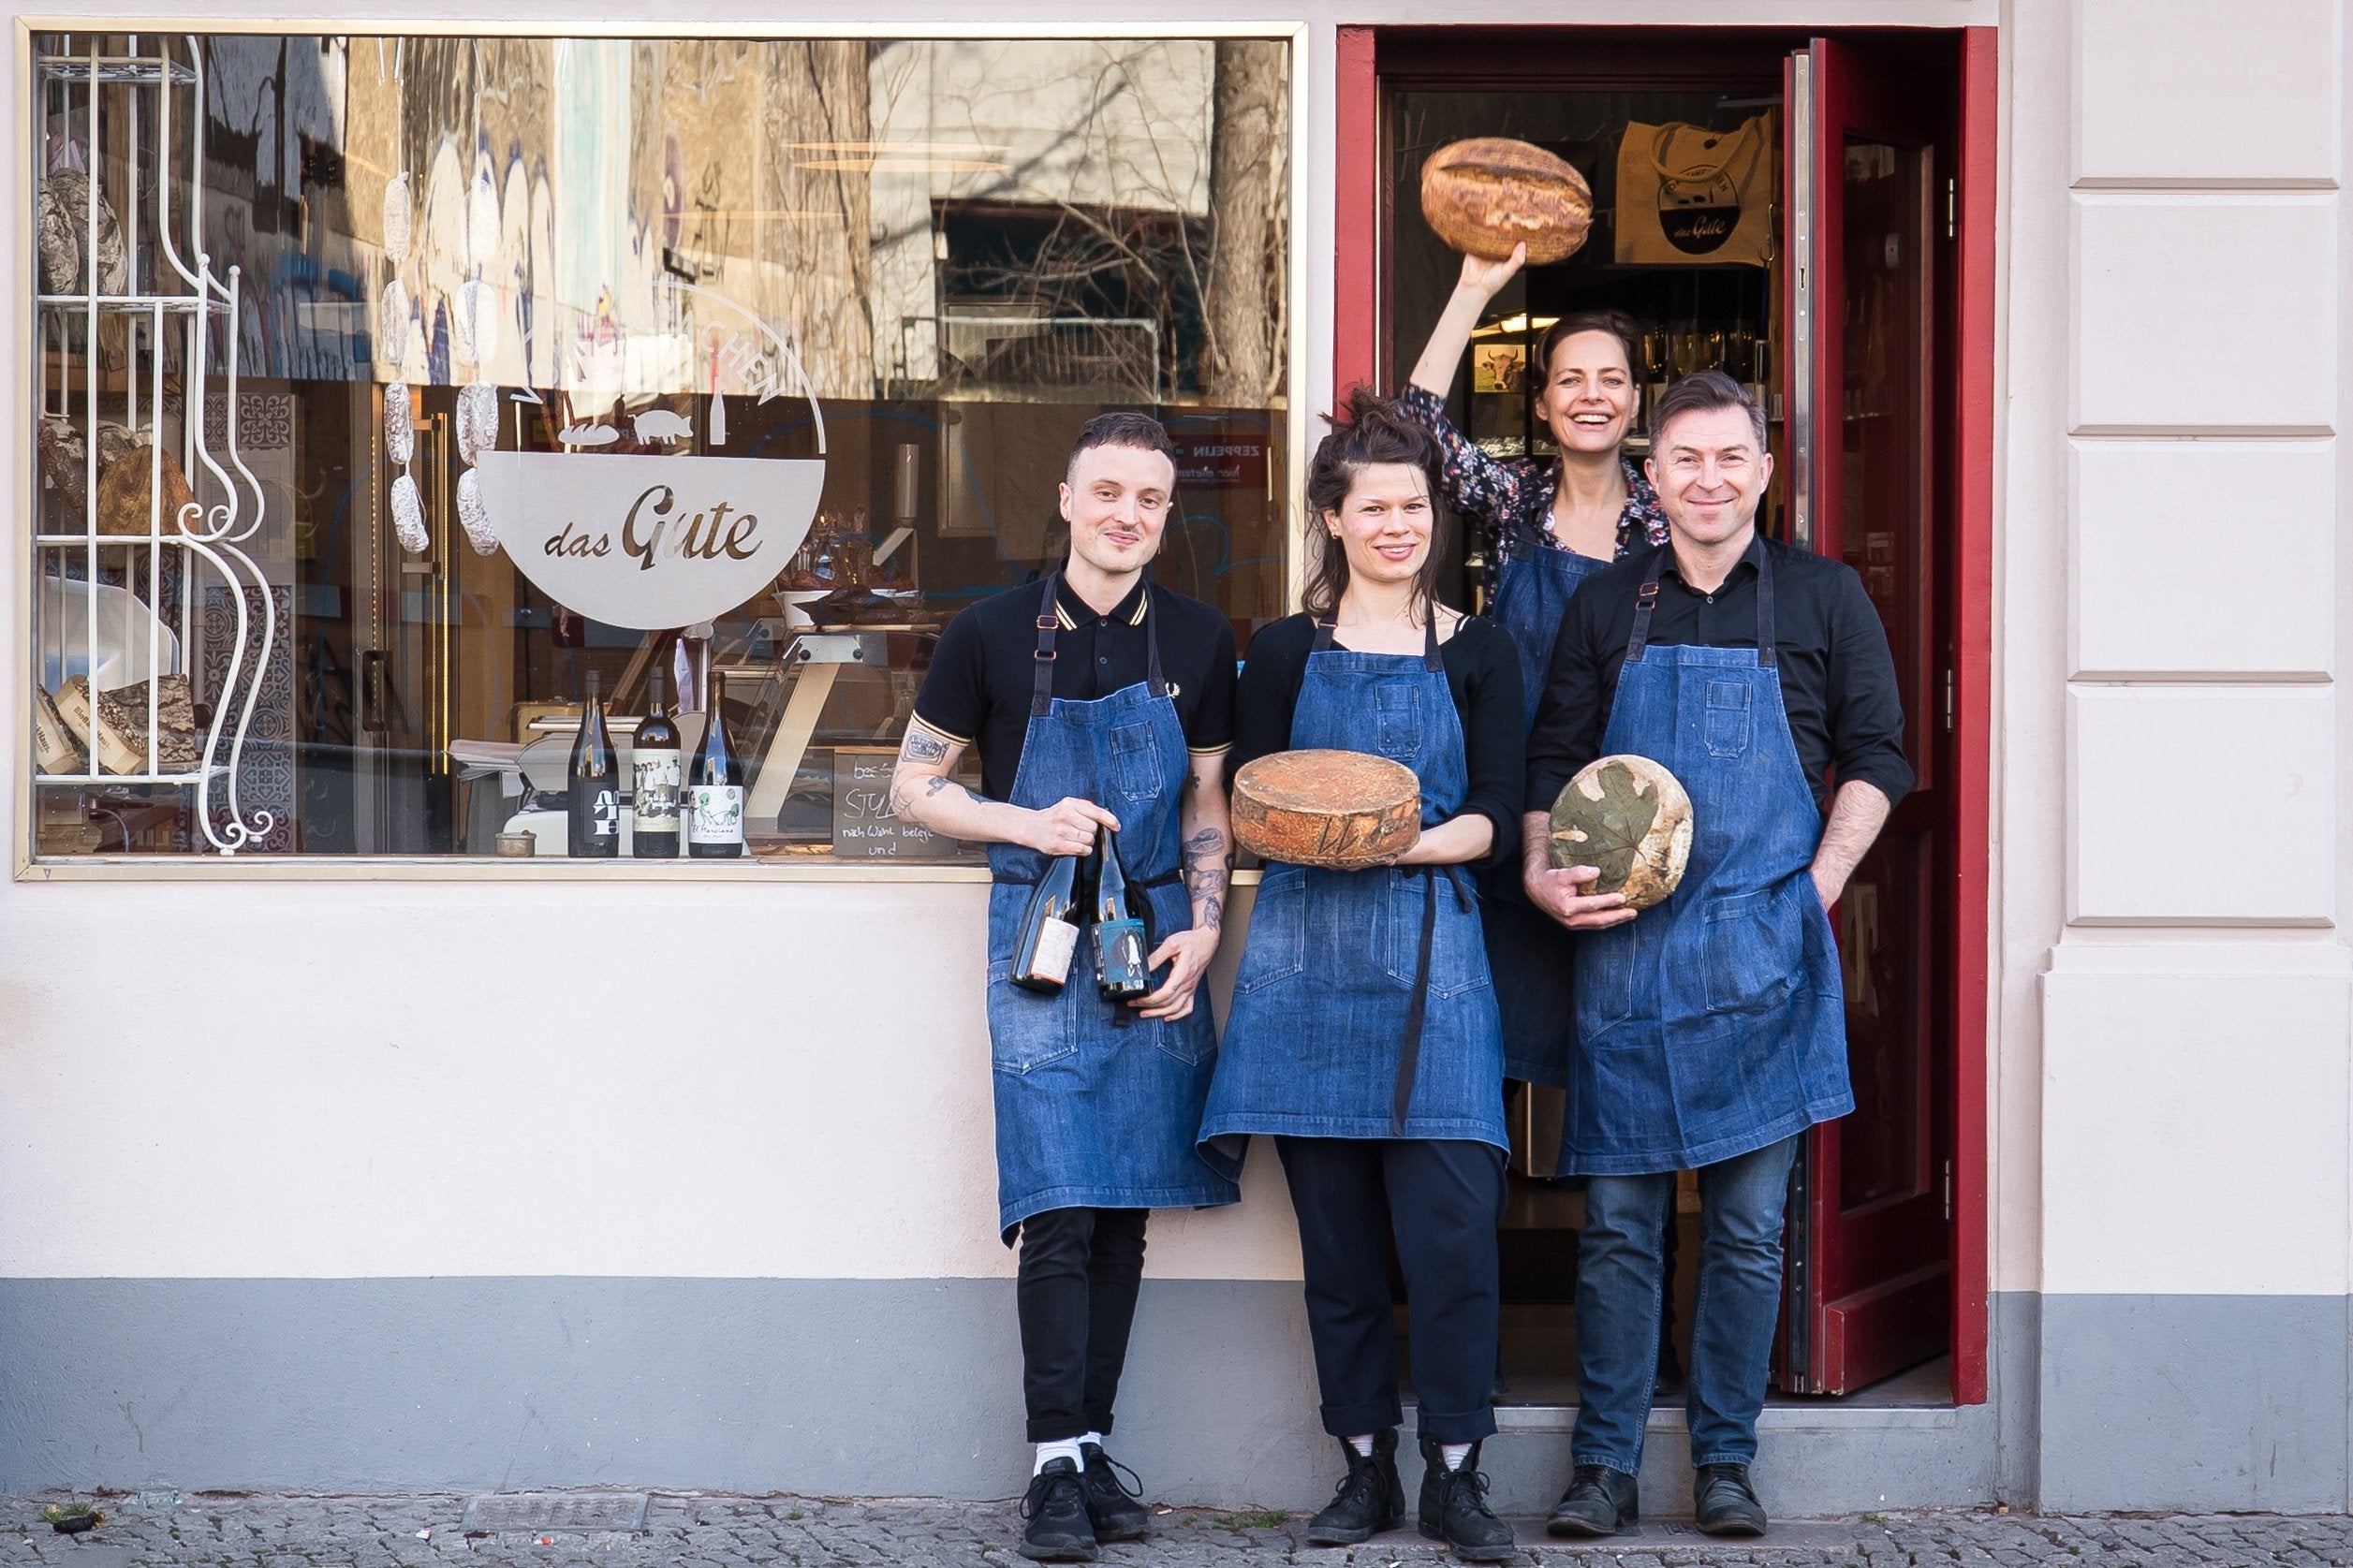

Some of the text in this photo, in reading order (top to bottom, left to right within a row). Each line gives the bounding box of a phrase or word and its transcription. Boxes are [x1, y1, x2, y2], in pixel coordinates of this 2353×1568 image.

[544, 484, 763, 570] das Gute
[843, 826, 865, 838] nach
[867, 825, 895, 838] Wahl
[868, 842, 896, 856] und
